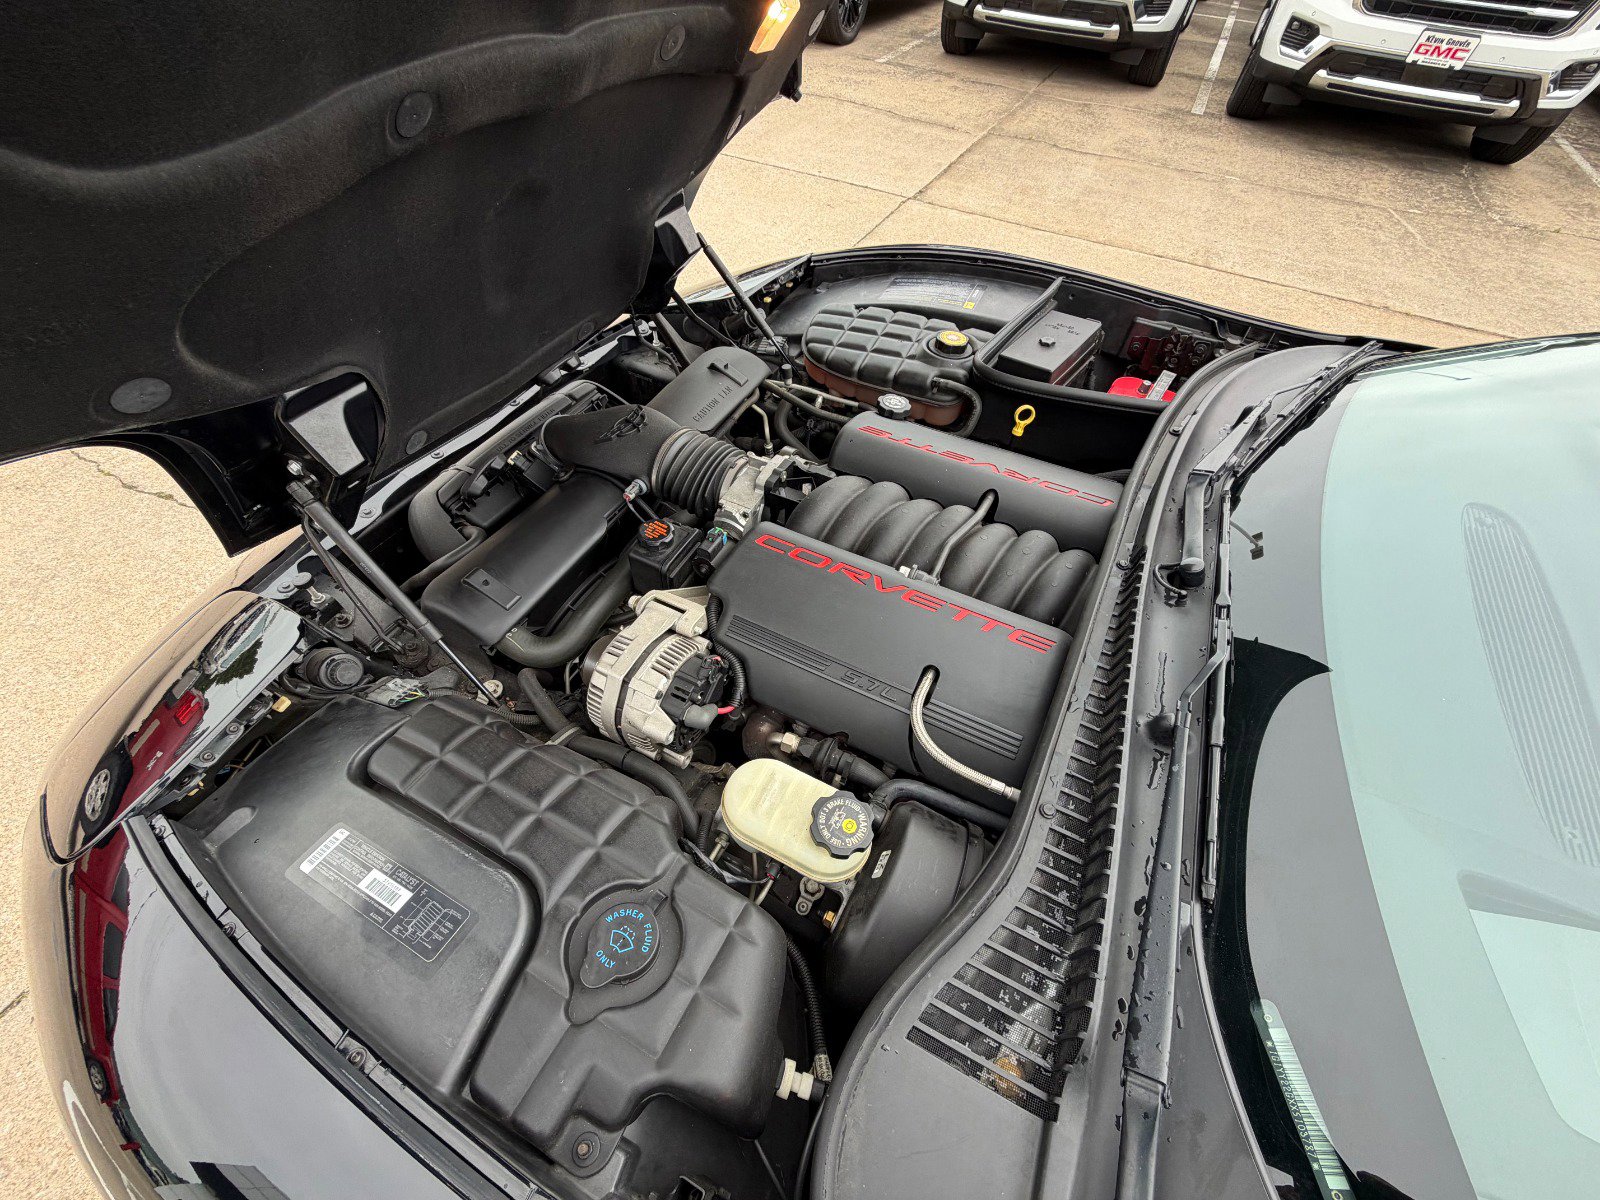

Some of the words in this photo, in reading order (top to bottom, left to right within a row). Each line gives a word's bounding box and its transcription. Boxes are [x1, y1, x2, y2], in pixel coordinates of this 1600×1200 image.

[1413, 43, 1471, 61] GMC
[858, 424, 1115, 508] CORVETTE
[754, 533, 1057, 654] CORVETTE
[840, 671, 897, 702] 5.7L
[826, 798, 844, 809] BRAKE
[844, 799, 861, 811] FLUID
[845, 812, 867, 846] WARNING
[829, 836, 841, 846] USE
[395, 868, 420, 887] CATALYST
[605, 909, 645, 923] WASHER
[643, 923, 653, 953] FLUID
[595, 949, 617, 969] ONLY
